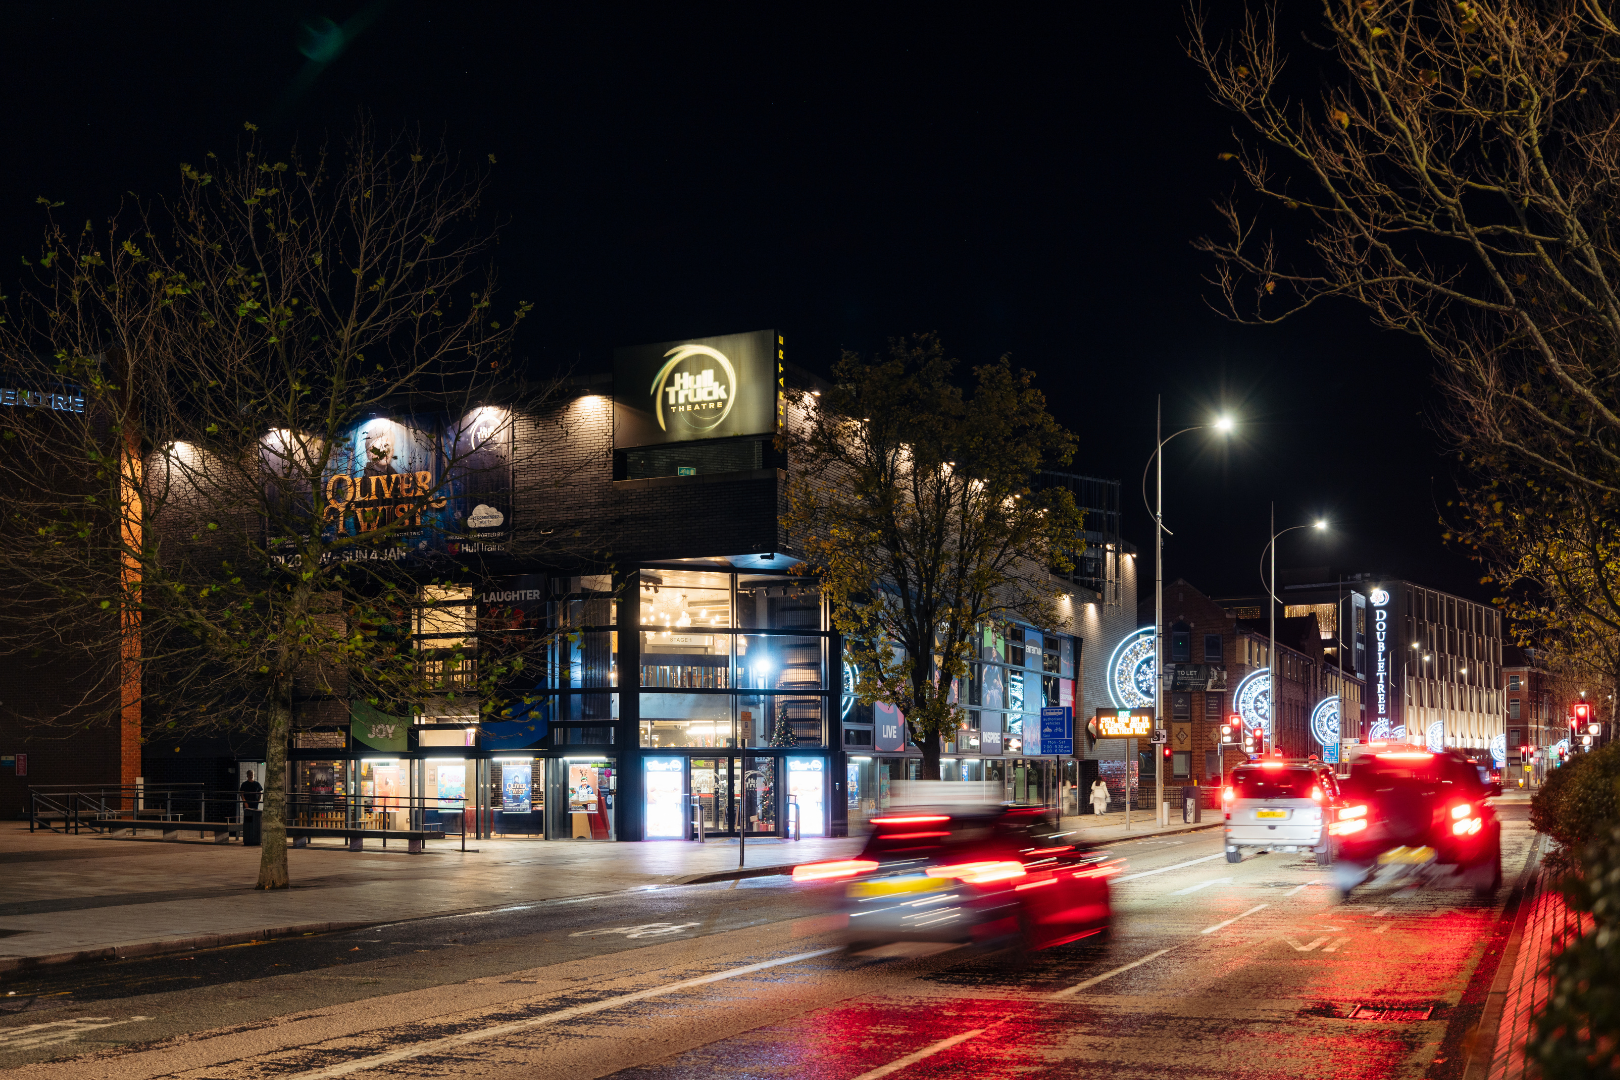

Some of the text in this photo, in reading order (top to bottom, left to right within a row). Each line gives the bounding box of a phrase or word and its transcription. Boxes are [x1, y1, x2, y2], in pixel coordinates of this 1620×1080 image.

[674, 369, 715, 390] Hull
[665, 381, 728, 405] Truck
[670, 401, 723, 413] THEATRE
[325, 470, 432, 506] OLIVER
[323, 502, 428, 534] TWIST
[288, 553, 302, 568] 28
[341, 549, 368, 564] SUN
[370, 549, 378, 560] 4
[379, 546, 407, 562] JAN
[461, 543, 480, 553] Hull
[482, 589, 541, 604] LAUGHTER
[1375, 609, 1387, 715] DOUBLETREE
[367, 724, 396, 739] JOY
[882, 724, 897, 738] LIVE
[982, 731, 1001, 743] INSPIRE
